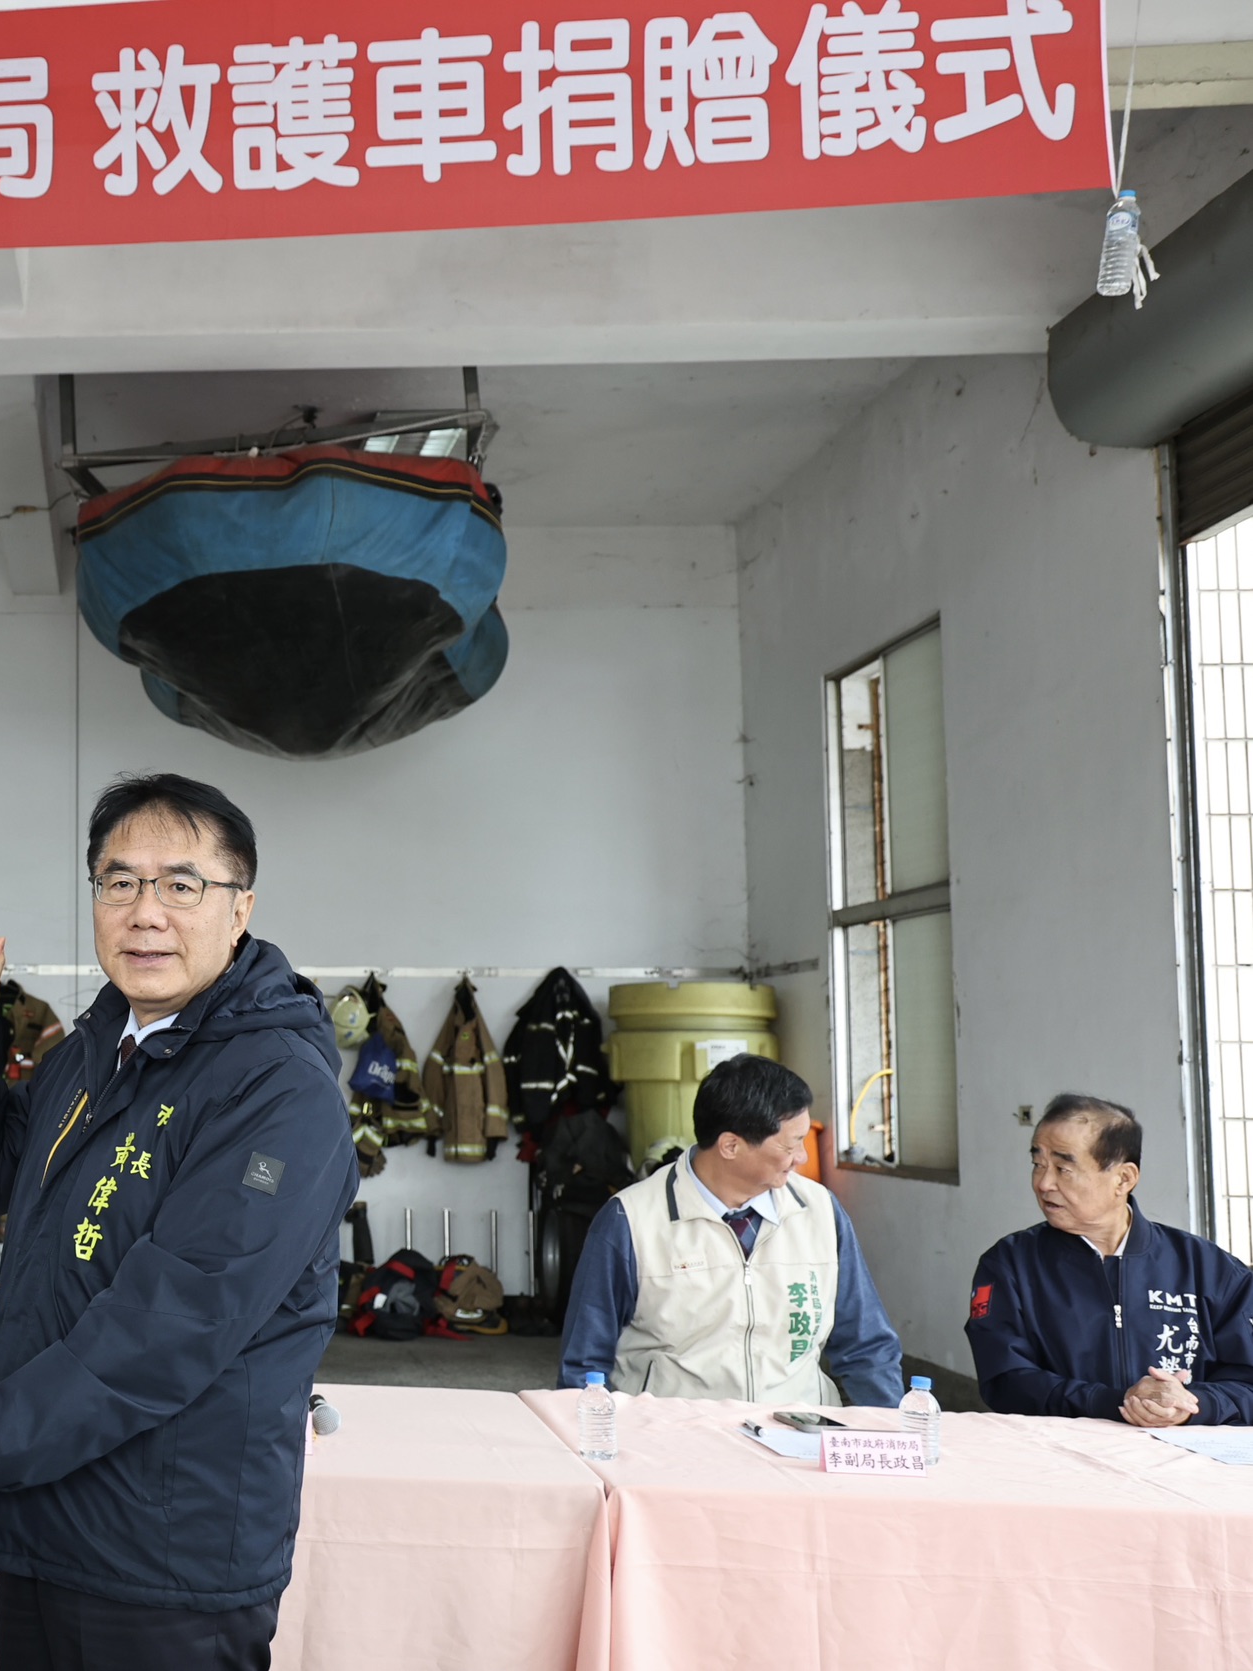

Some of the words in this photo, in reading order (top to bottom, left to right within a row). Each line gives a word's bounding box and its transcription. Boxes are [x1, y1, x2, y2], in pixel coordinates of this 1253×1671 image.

[91, 0, 1075, 197] 救護車捐贈儀式
[73, 1132, 136, 1261] 黃偉哲
[787, 1282, 811, 1362] 李政昌
[1148, 1289, 1197, 1307] KMT
[828, 1451, 924, 1471] 李副局長政昌
[829, 1436, 919, 1451] 臺南市政府消防局
